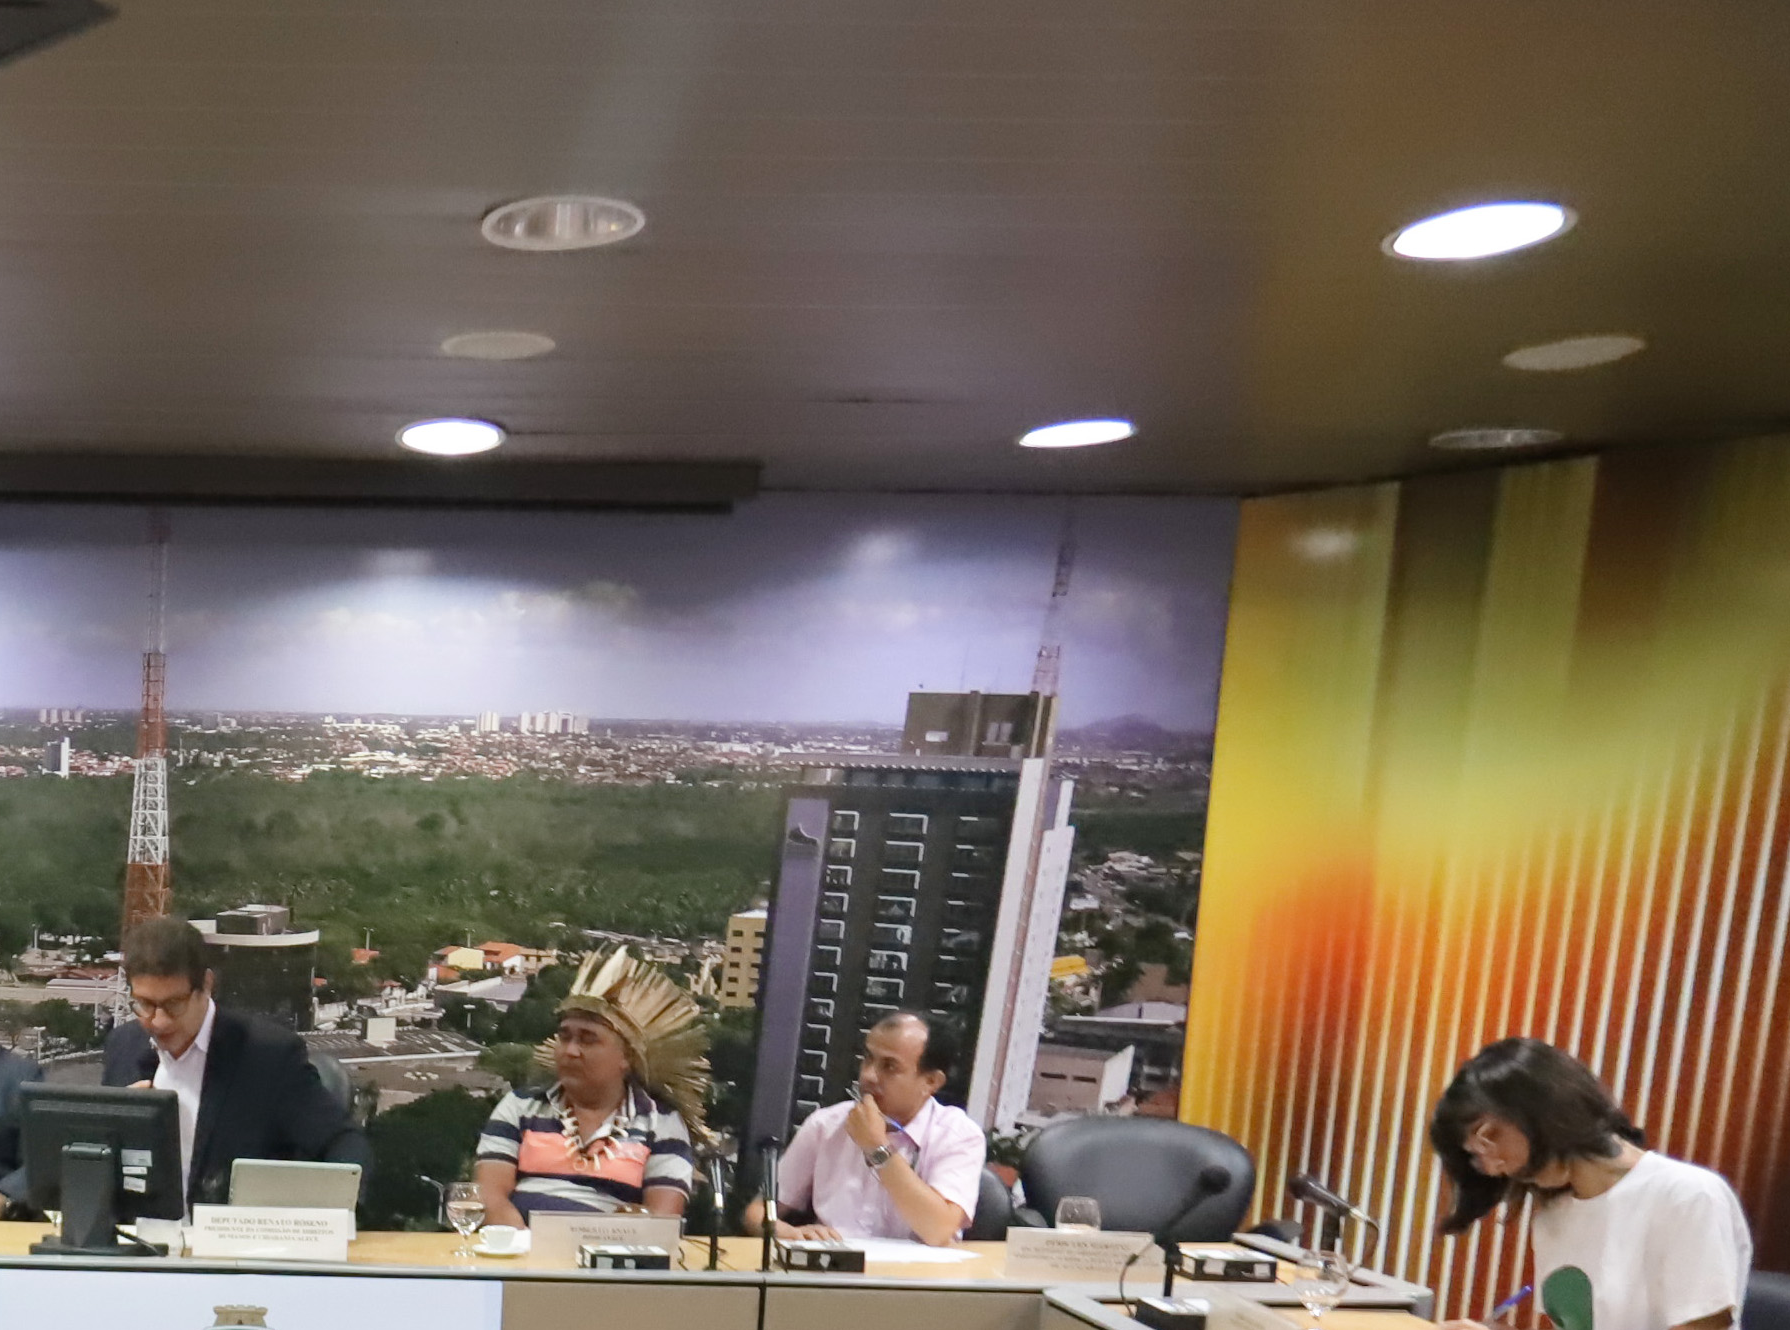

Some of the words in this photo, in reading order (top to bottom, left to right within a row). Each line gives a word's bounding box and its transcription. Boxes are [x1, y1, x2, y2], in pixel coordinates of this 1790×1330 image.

[210, 1216, 256, 1225] DEPUTADO
[257, 1217, 292, 1226] RENATO
[293, 1218, 328, 1227] ROSENO
